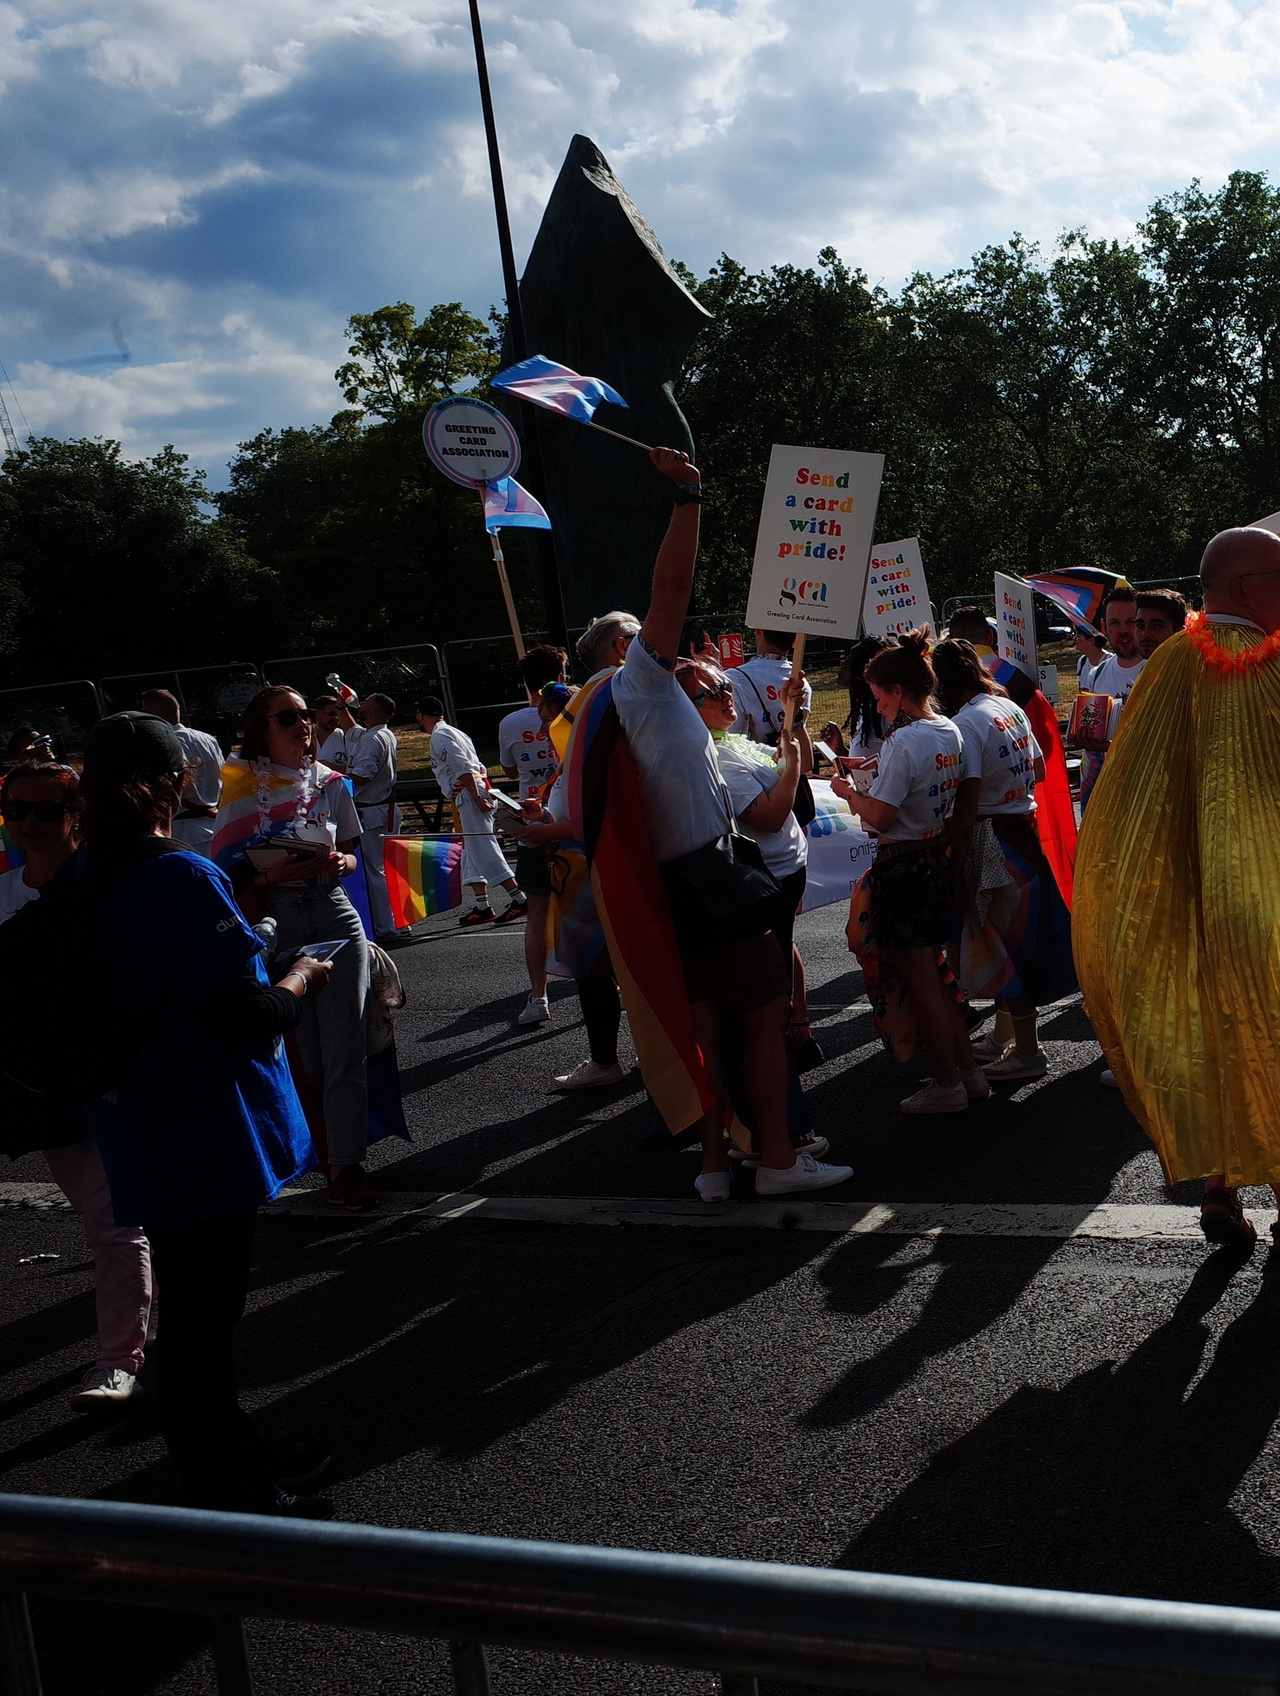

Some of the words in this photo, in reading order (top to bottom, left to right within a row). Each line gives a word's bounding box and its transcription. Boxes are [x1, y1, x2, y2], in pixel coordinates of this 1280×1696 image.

[445, 424, 496, 435] GREETING
[459, 436, 487, 446] CARD
[442, 447, 509, 458] ASSOCIATION
[796, 467, 850, 488] Send
[785, 495, 796, 507] a
[803, 496, 854, 513] card
[789, 517, 842, 536] with
[778, 540, 846, 561] pride!
[871, 553, 904, 569] Send
[870, 576, 878, 584] a
[881, 567, 911, 582] card
[877, 582, 910, 597] with
[876, 595, 916, 615] pride!
[1003, 592, 1022, 611] Send
[767, 610, 790, 620] Greeting
[791, 613, 805, 621] Card
[805, 615, 837, 625] Association
[1003, 611, 1008, 621] a
[1008, 614, 1026, 631] card
[1006, 629, 1025, 647] with
[1005, 646, 1029, 665] pride!
[520, 752, 531, 762] a
[998, 744, 1010, 759] a
[928, 784, 939, 798] a
